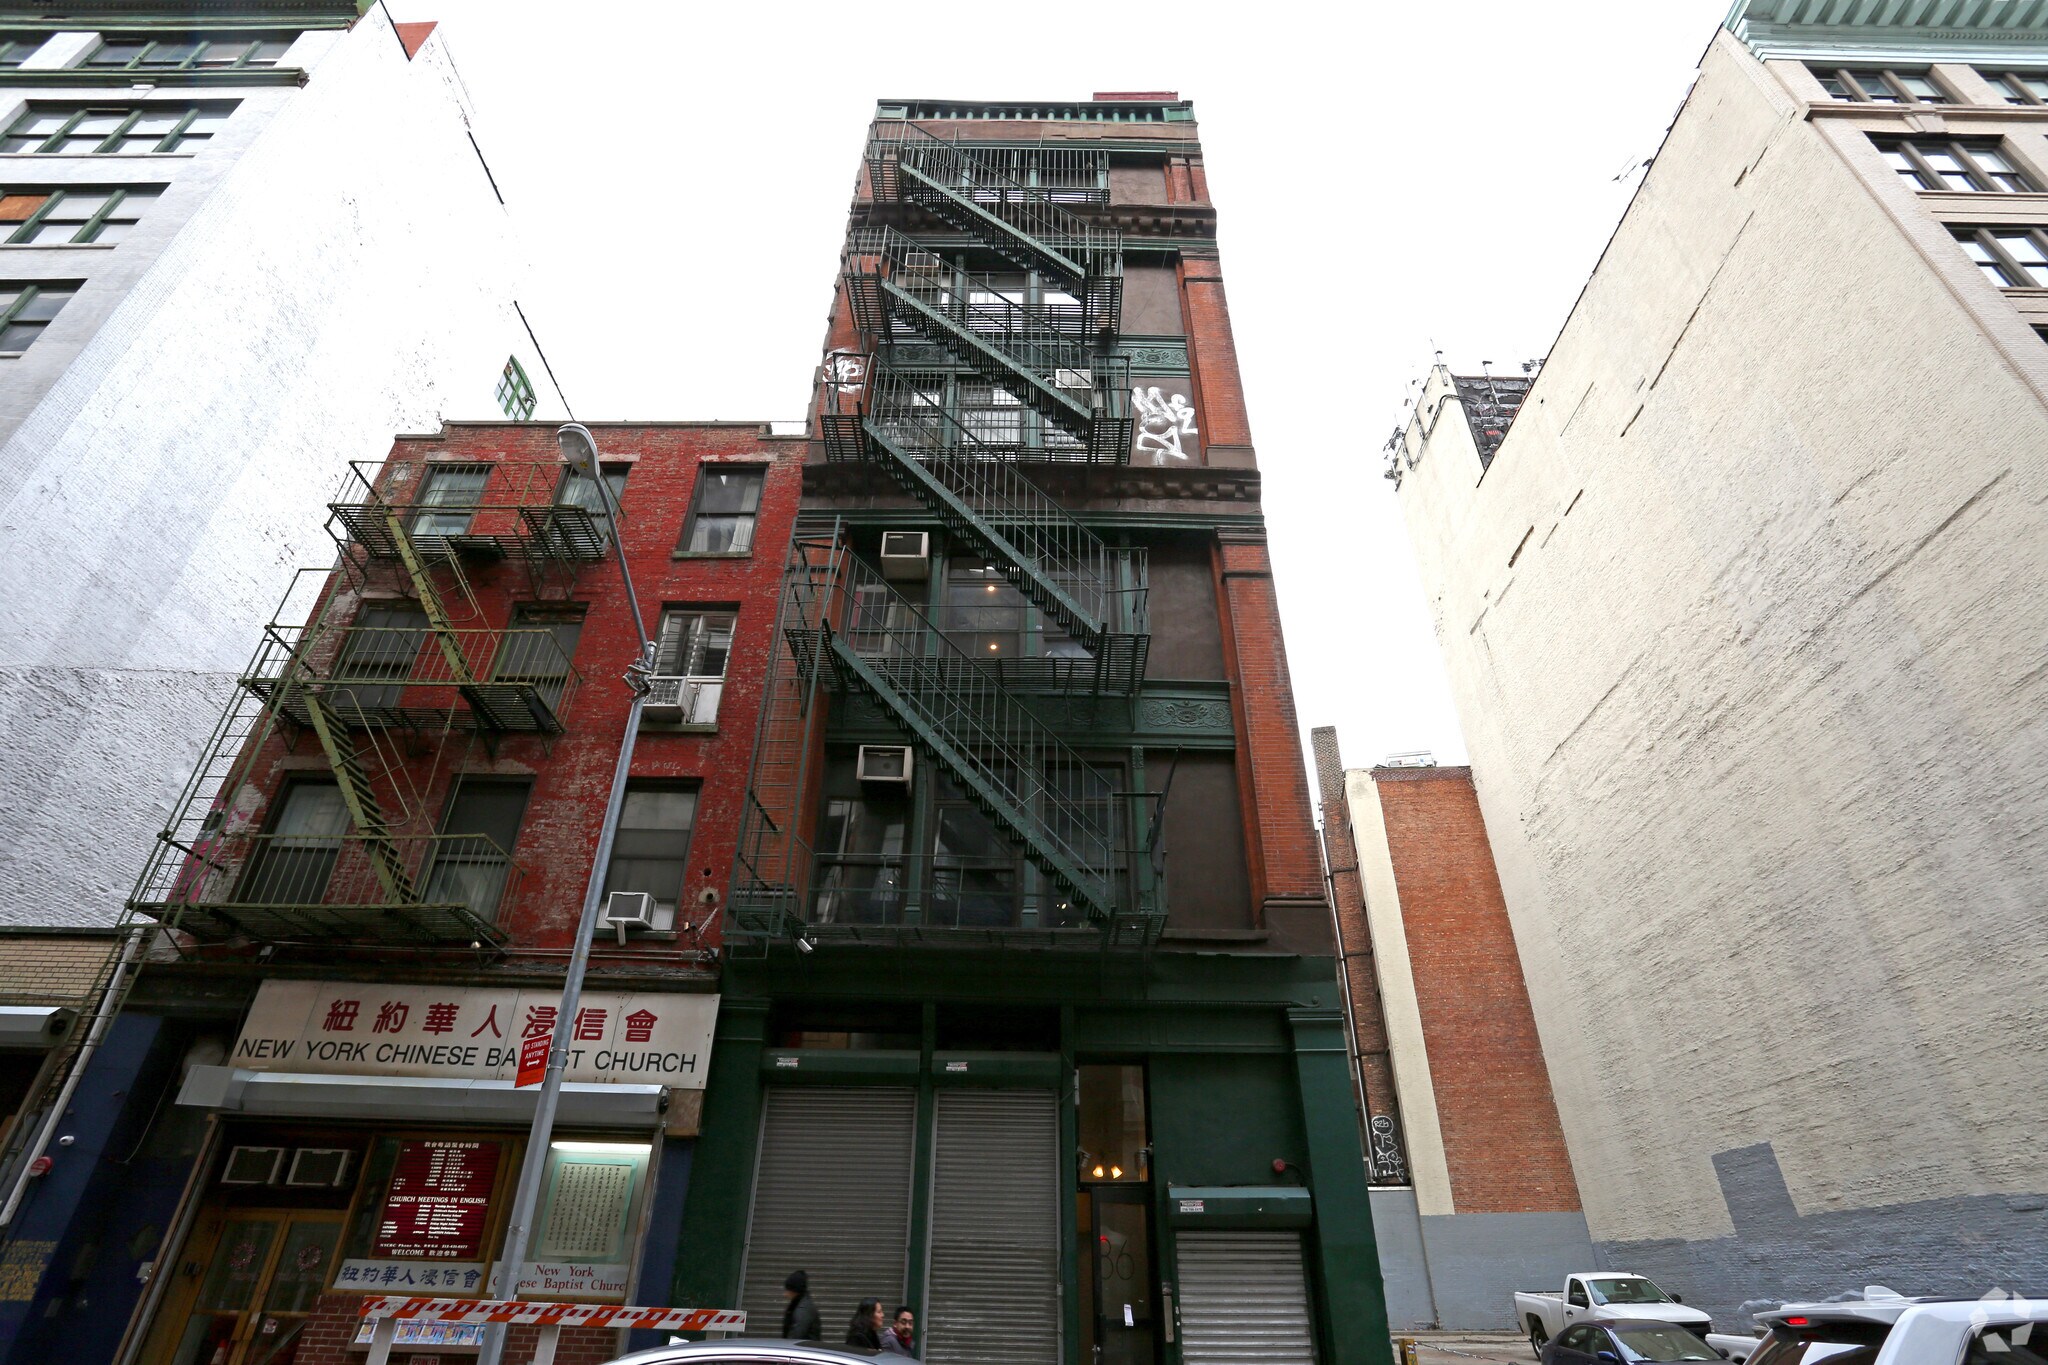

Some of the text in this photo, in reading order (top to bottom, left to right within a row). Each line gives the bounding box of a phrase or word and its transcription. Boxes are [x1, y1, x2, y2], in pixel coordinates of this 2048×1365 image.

[322, 999, 658, 1043] 紐約華人浸信會
[531, 1039, 550, 1050] STANDING
[237, 1038, 295, 1059] NEW
[306, 1041, 371, 1062] YORK
[375, 1043, 479, 1066] CHINESE
[594, 1050, 697, 1073] CHURCH
[525, 1049, 545, 1060] ANYTIME
[389, 1195, 416, 1203] CHURCH
[341, 1265, 482, 1288] 紐約華人浸信會
[535, 1265, 595, 1277] New York
[543, 1278, 583, 1293] Baptist
[590, 1279, 626, 1292] Churc
